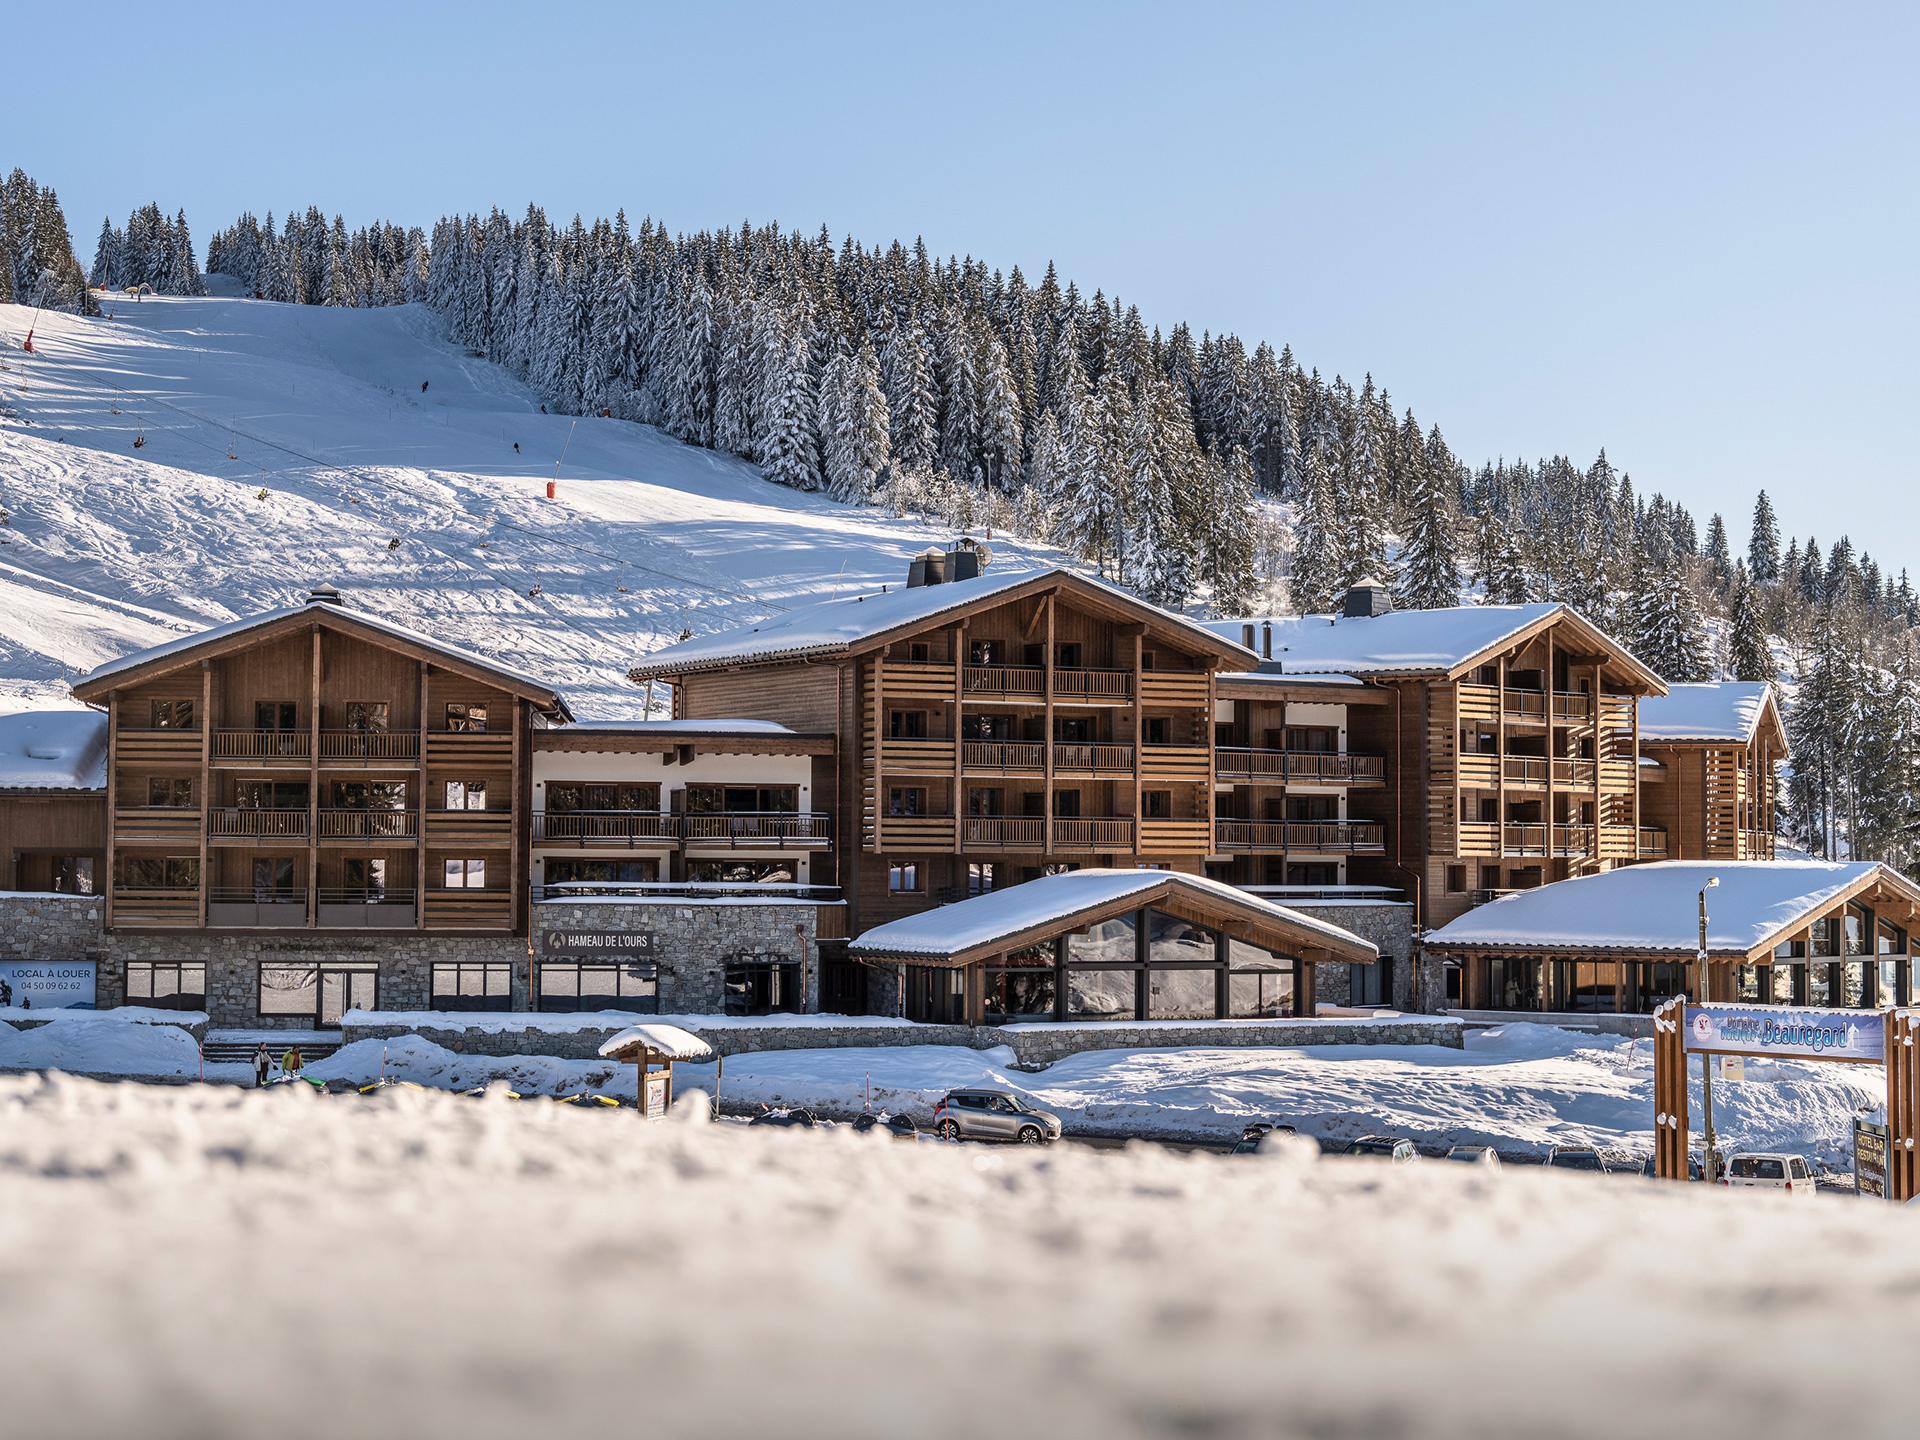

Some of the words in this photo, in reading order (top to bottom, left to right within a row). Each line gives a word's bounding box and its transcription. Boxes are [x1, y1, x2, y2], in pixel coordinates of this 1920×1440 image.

[568, 935, 603, 947] HAMEAU
[605, 935, 616, 947] DE
[618, 935, 648, 947] L'OURS
[12, 969, 44, 978] LOCAL
[47, 968, 54, 978] À
[57, 969, 91, 978] LOUER
[21, 981, 31, 990] 04
[34, 981, 44, 990] 50
[46, 981, 56, 990] 09
[58, 981, 68, 990] 62
[70, 981, 81, 990] 62
[1763, 1018, 1848, 1052] Beauregard
